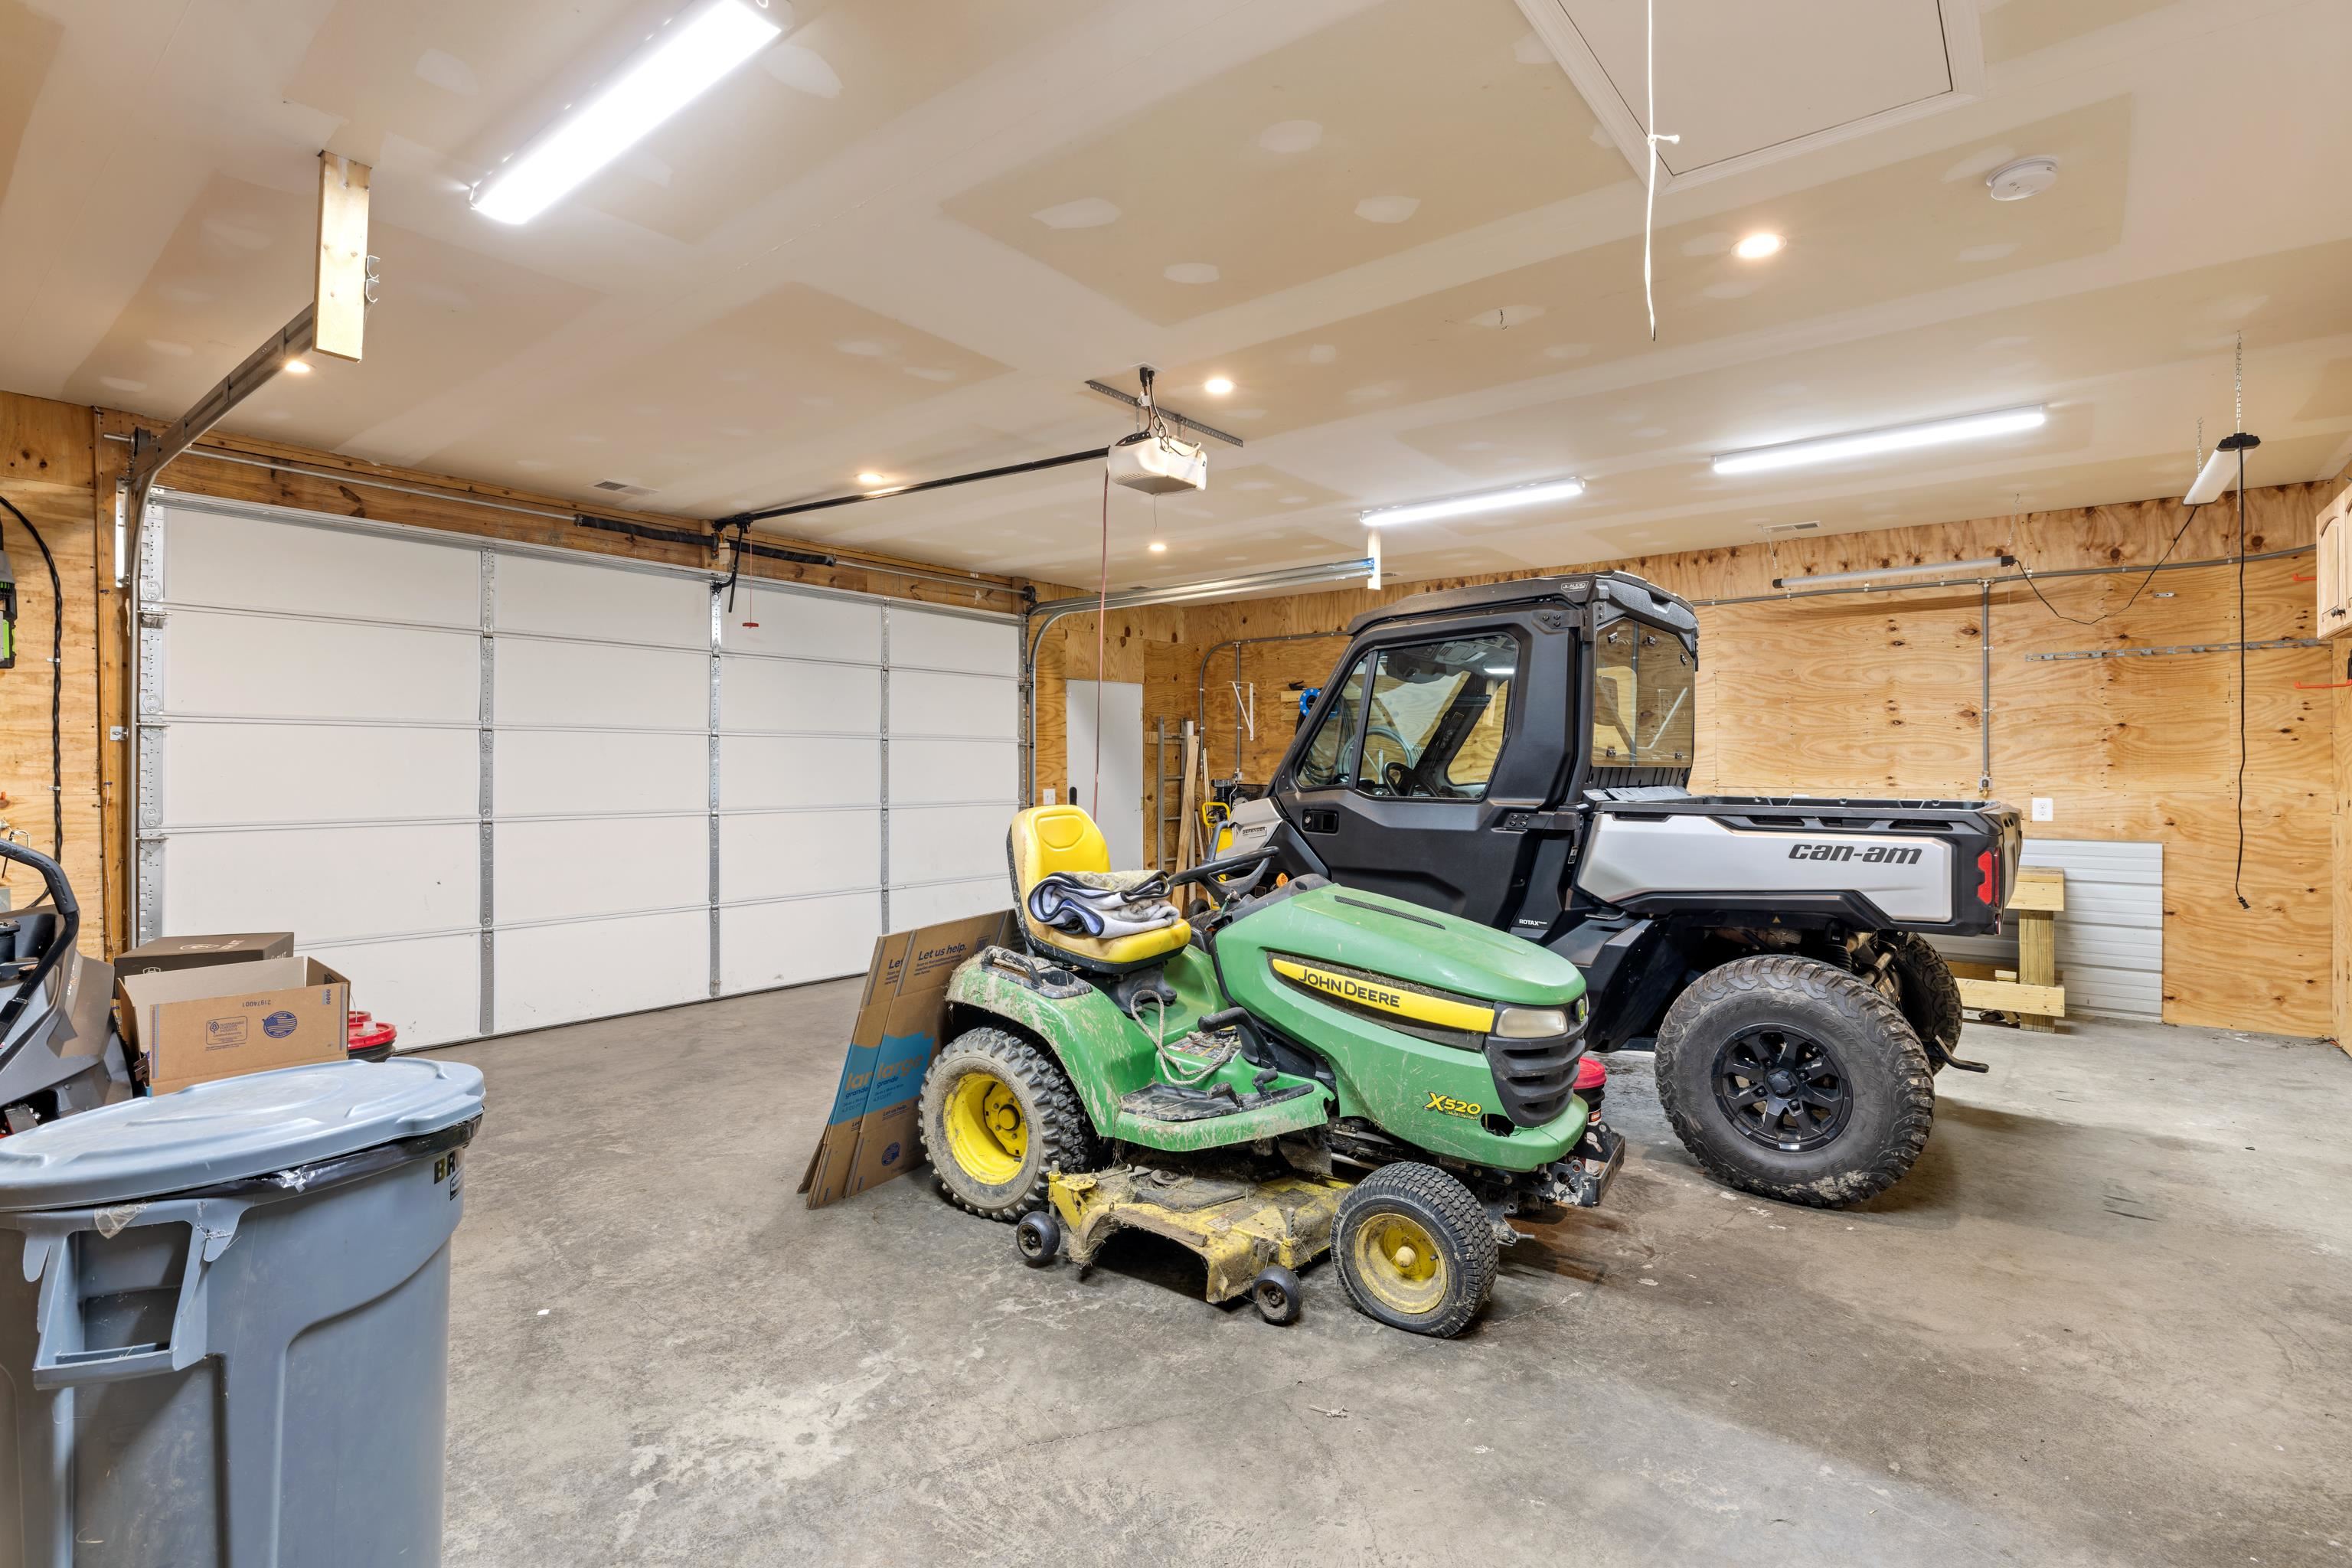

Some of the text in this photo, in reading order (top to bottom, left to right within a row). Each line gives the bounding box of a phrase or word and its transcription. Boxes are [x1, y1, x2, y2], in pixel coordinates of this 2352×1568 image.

[1242, 826, 1266, 835] DEFENDER
[1788, 844, 1923, 864] can-am
[919, 942, 967, 960] Let us help.
[1298, 969, 1400, 1008] JOHN DEERE
[877, 1055, 923, 1080] large
[844, 1072, 874, 1091] lar
[876, 1076, 900, 1088] grande
[1424, 1091, 1482, 1116] X520
